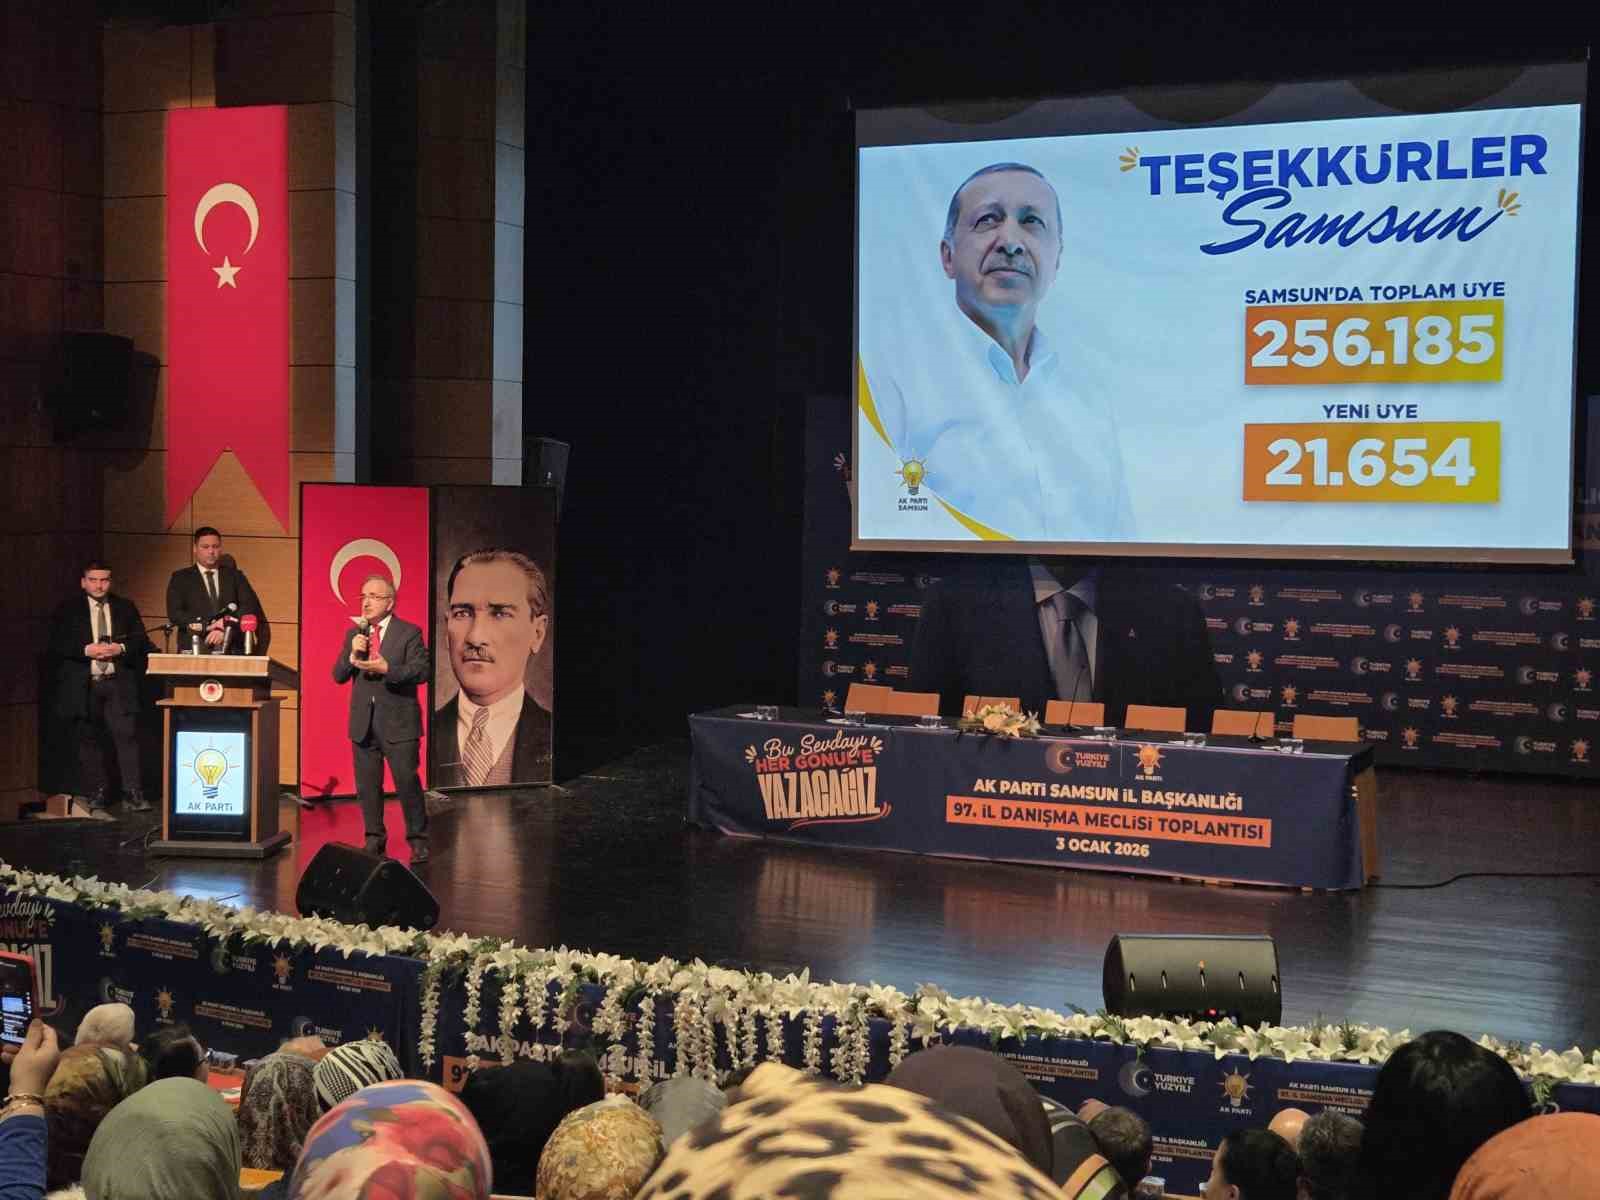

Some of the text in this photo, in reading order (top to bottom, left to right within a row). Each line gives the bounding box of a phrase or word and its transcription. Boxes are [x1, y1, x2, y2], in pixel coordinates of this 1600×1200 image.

[1138, 134, 1548, 200] TEŞEKKÜRLER
[1199, 187, 1504, 256] Samsun
[1244, 281, 1506, 304] SAMSUN'DA TOPLAM ÜYE
[1251, 314, 1496, 368] 256.185
[1322, 403, 1419, 420] YENİ ÜYE
[1265, 437, 1477, 486] 21.654
[755, 757, 790, 773] HER
[763, 738, 795, 760] Bu
[187, 802, 201, 811] AK
[757, 766, 881, 820] YAZACAĞIZ
[974, 778, 1243, 811] AK PARTİ SAMSUN İL BAŞKANLIĞI
[953, 802, 1264, 840] 97. İL DANIŞMA MECLİSİ TOPLANTISI
[1056, 837, 1150, 858] 3 OCAK 2026
